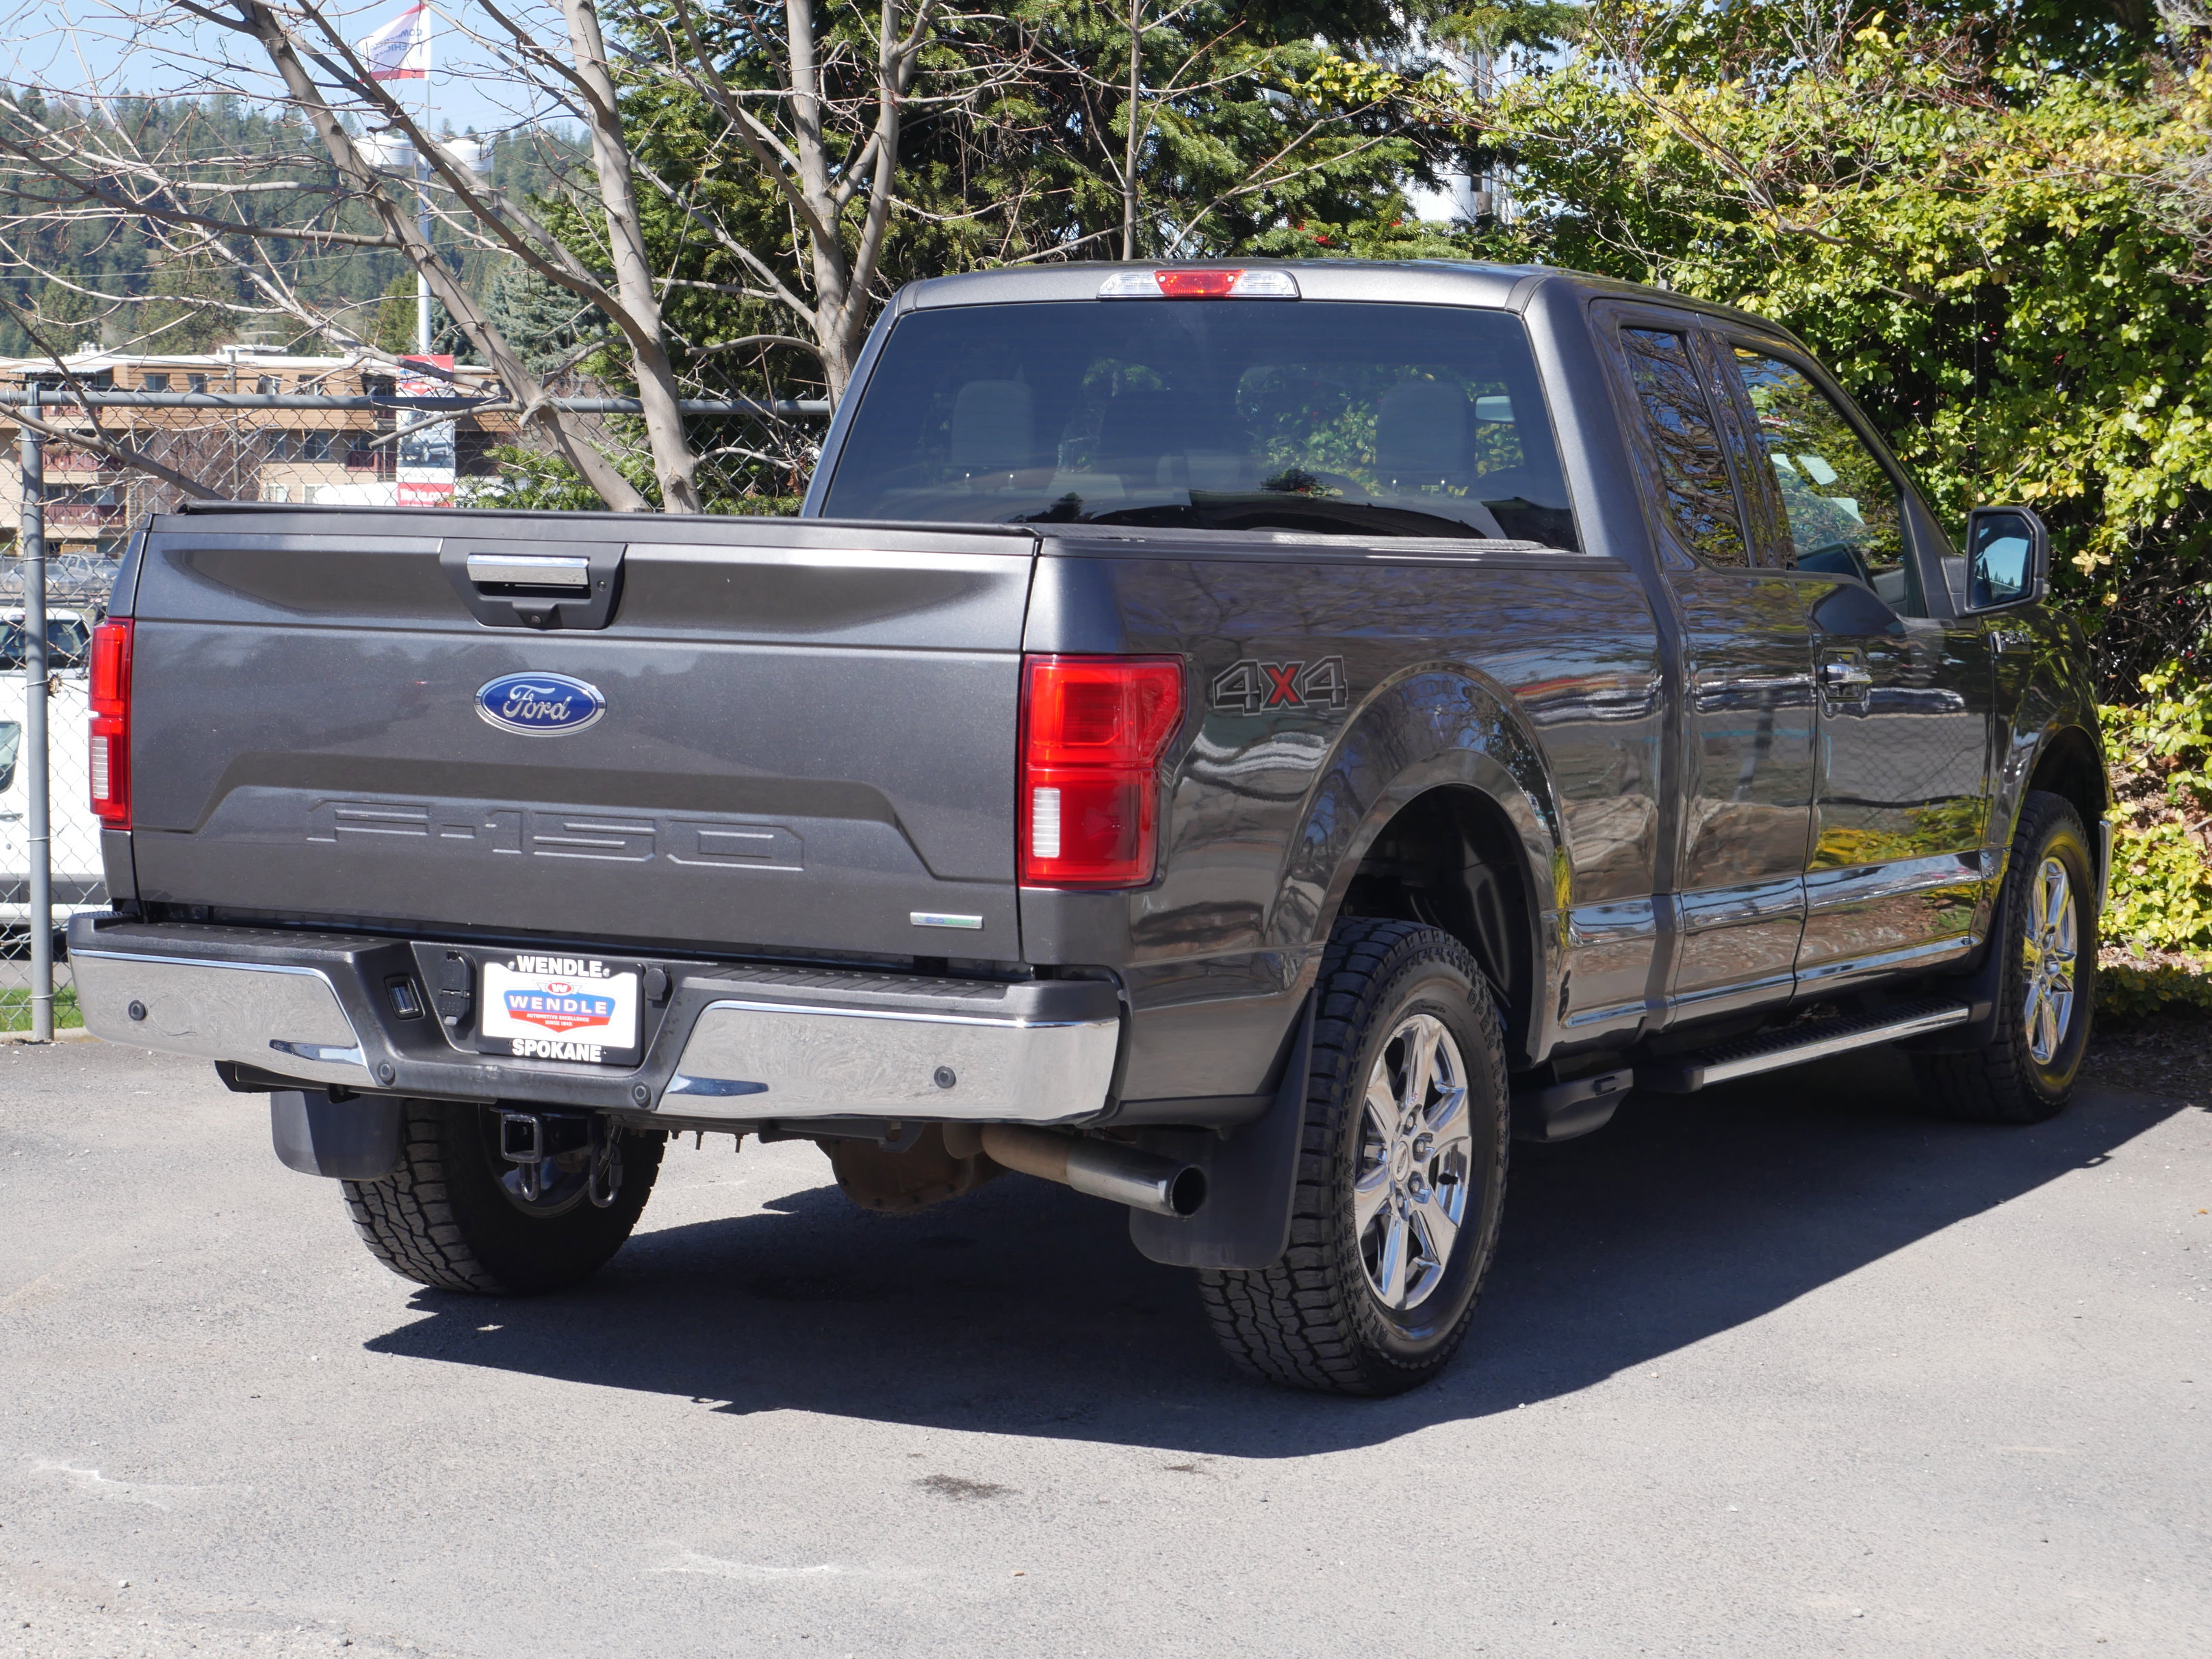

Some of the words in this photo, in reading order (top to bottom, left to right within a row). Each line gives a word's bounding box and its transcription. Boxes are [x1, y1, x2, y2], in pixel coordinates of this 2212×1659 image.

[503, 684, 573, 721] Ford
[517, 955, 602, 978] WENDLE
[509, 995, 607, 1014] WENDLE
[513, 1038, 601, 1062] SPOKANE
[1467, 987, 1497, 1051] OPEN
[1491, 1060, 1508, 1168] RANGE
[1343, 1159, 1366, 1302] TERRAIN
[1365, 1303, 1389, 1344] ALL
